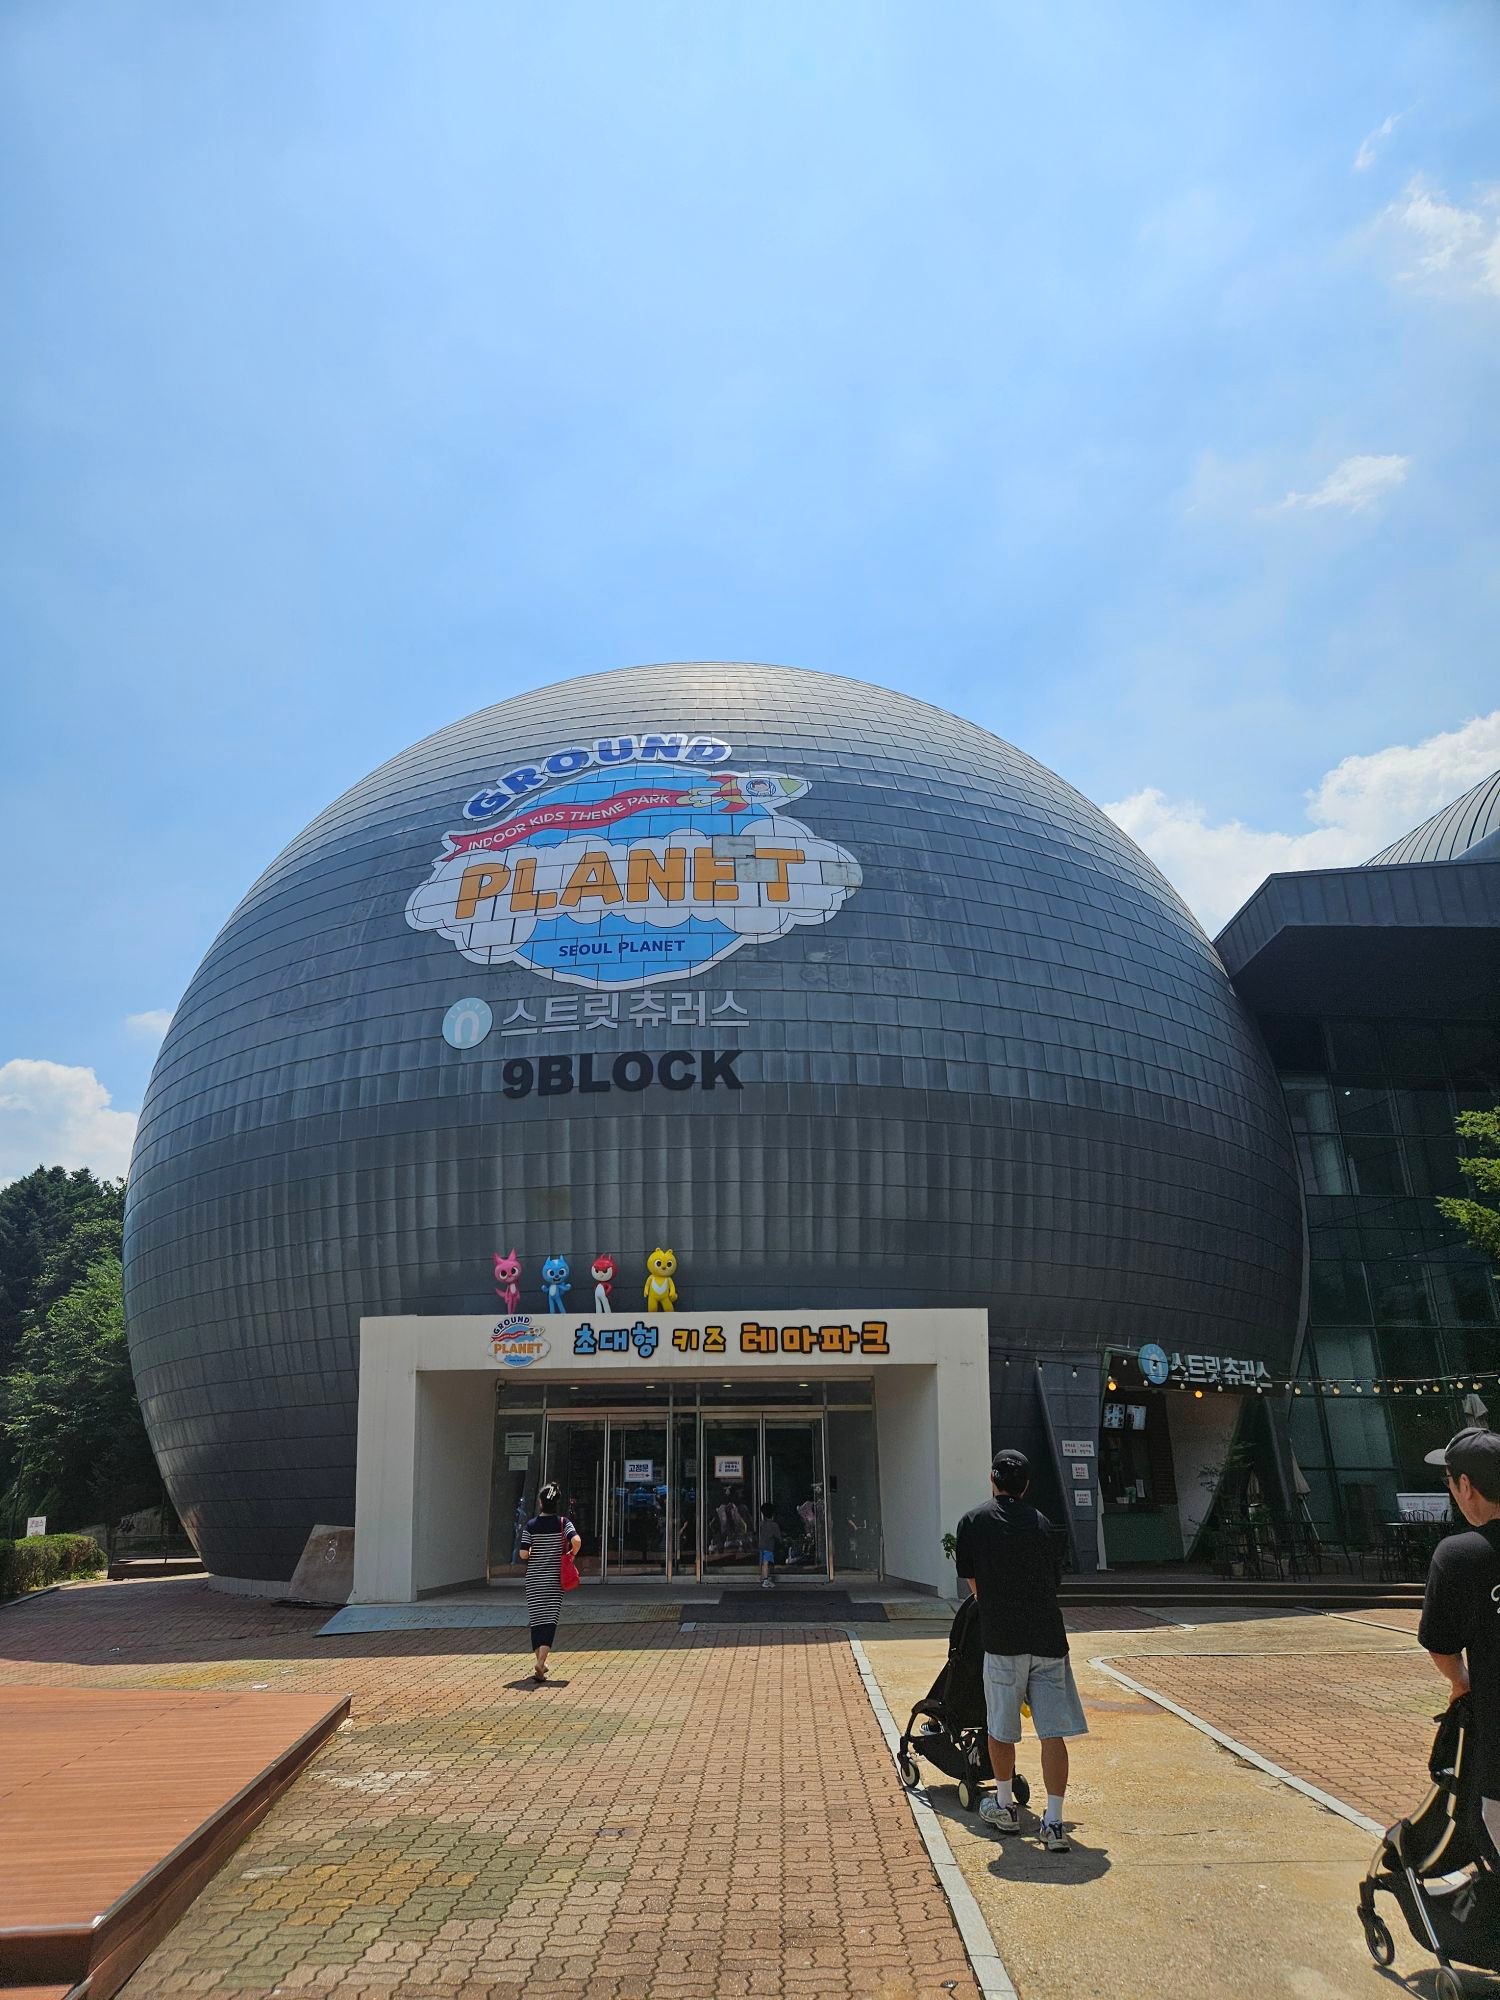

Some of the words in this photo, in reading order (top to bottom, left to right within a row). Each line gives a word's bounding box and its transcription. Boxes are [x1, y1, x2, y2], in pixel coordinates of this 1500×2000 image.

[464, 734, 730, 819] GROUND
[468, 823, 527, 850] INDOOR
[529, 811, 564, 827] KIDS
[569, 802, 626, 821] THEME
[628, 794, 671, 807] PARK
[455, 847, 806, 919] PLANET
[558, 942, 613, 957] SEOUL
[618, 939, 686, 954] PLANET
[501, 990, 750, 1037] 스트릿츄러스
[502, 1050, 745, 1099] 9BLOCK
[493, 1315, 530, 1335] GROUND
[494, 1343, 543, 1354] PLANET
[573, 1321, 659, 1358] 초대형
[672, 1326, 727, 1353] 키즈
[741, 1321, 890, 1354] 테마파크
